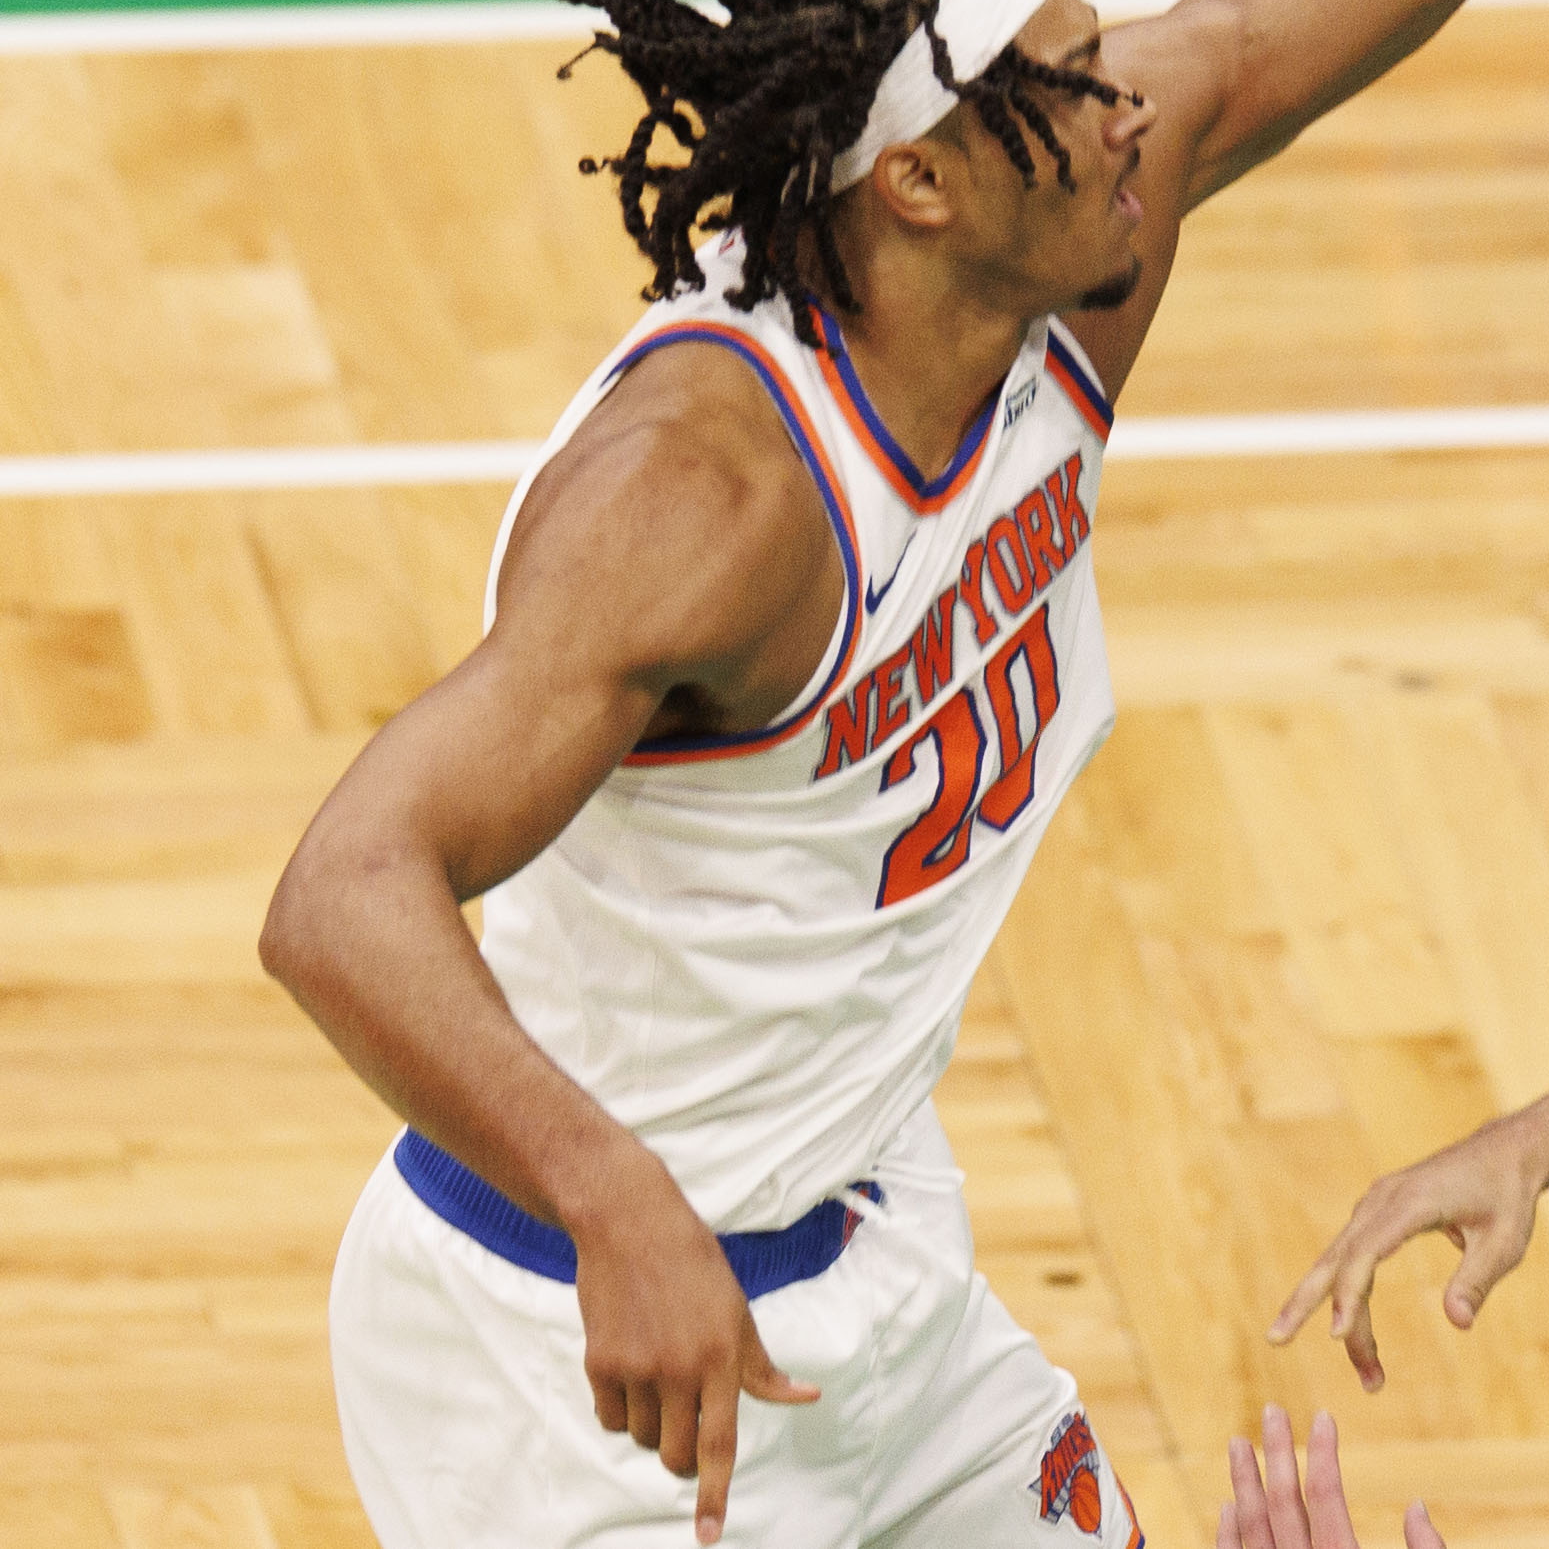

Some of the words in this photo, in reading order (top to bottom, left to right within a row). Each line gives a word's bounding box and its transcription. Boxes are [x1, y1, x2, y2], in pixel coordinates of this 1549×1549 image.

[811, 587, 958, 782] NEW
[955, 452, 1091, 645] YORK
[874, 601, 1060, 912] 20
